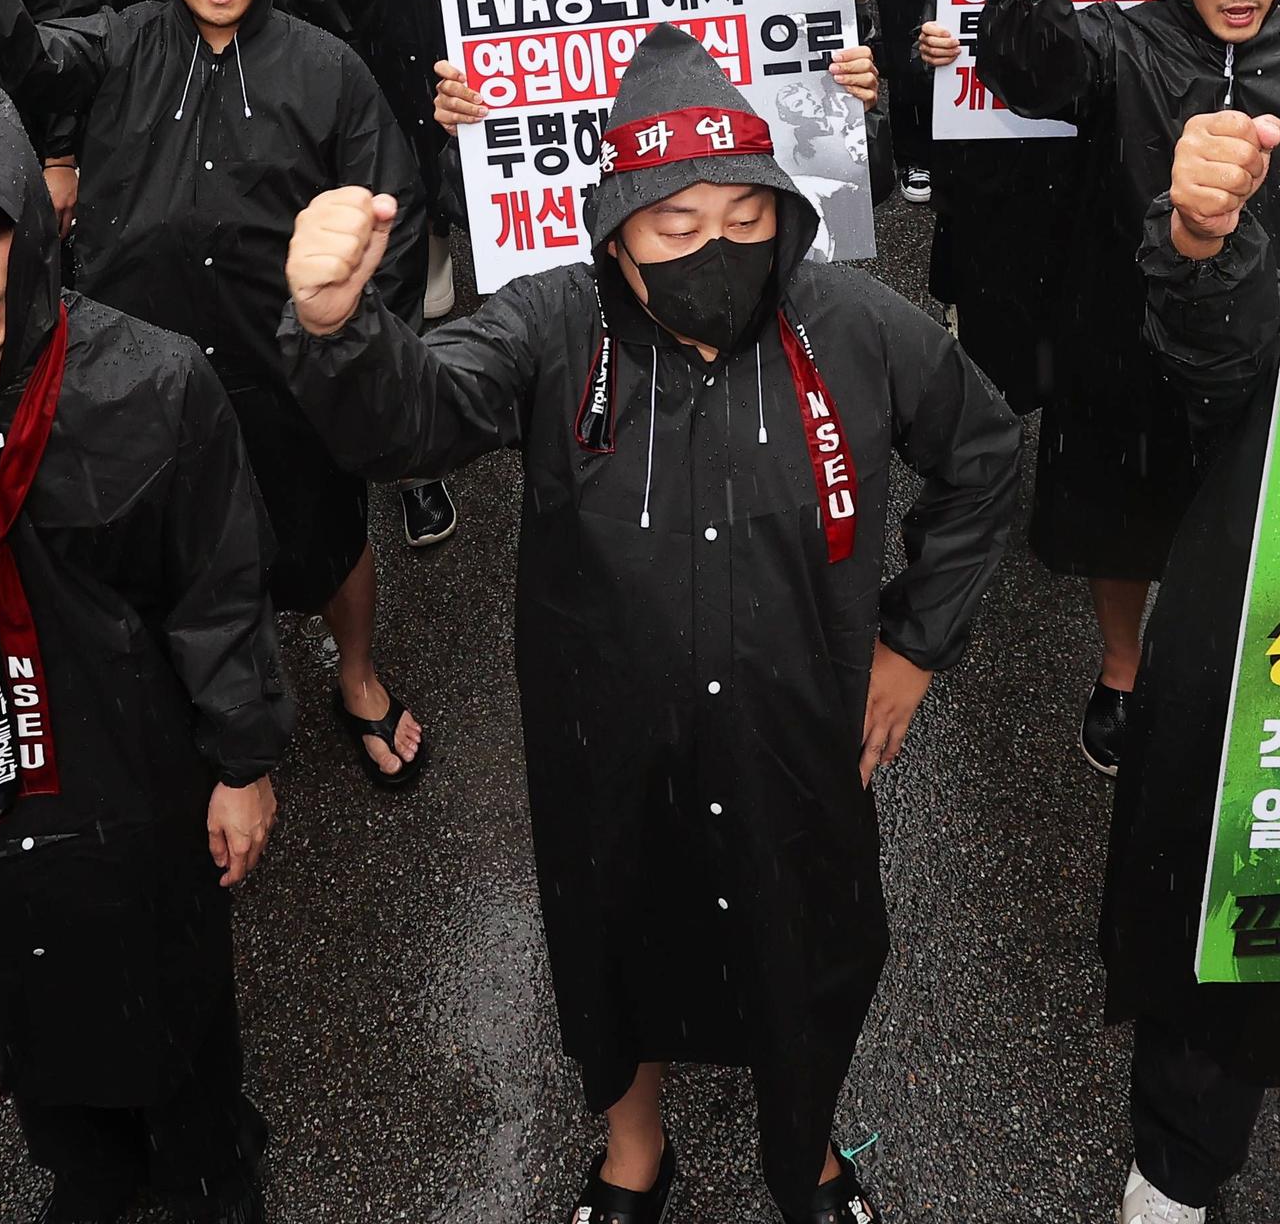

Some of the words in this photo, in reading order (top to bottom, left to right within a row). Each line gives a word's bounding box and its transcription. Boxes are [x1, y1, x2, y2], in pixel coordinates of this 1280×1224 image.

[761, 10, 846, 76] 으로
[806, 389, 856, 520] NSEU
[8, 656, 47, 771] NSEU
